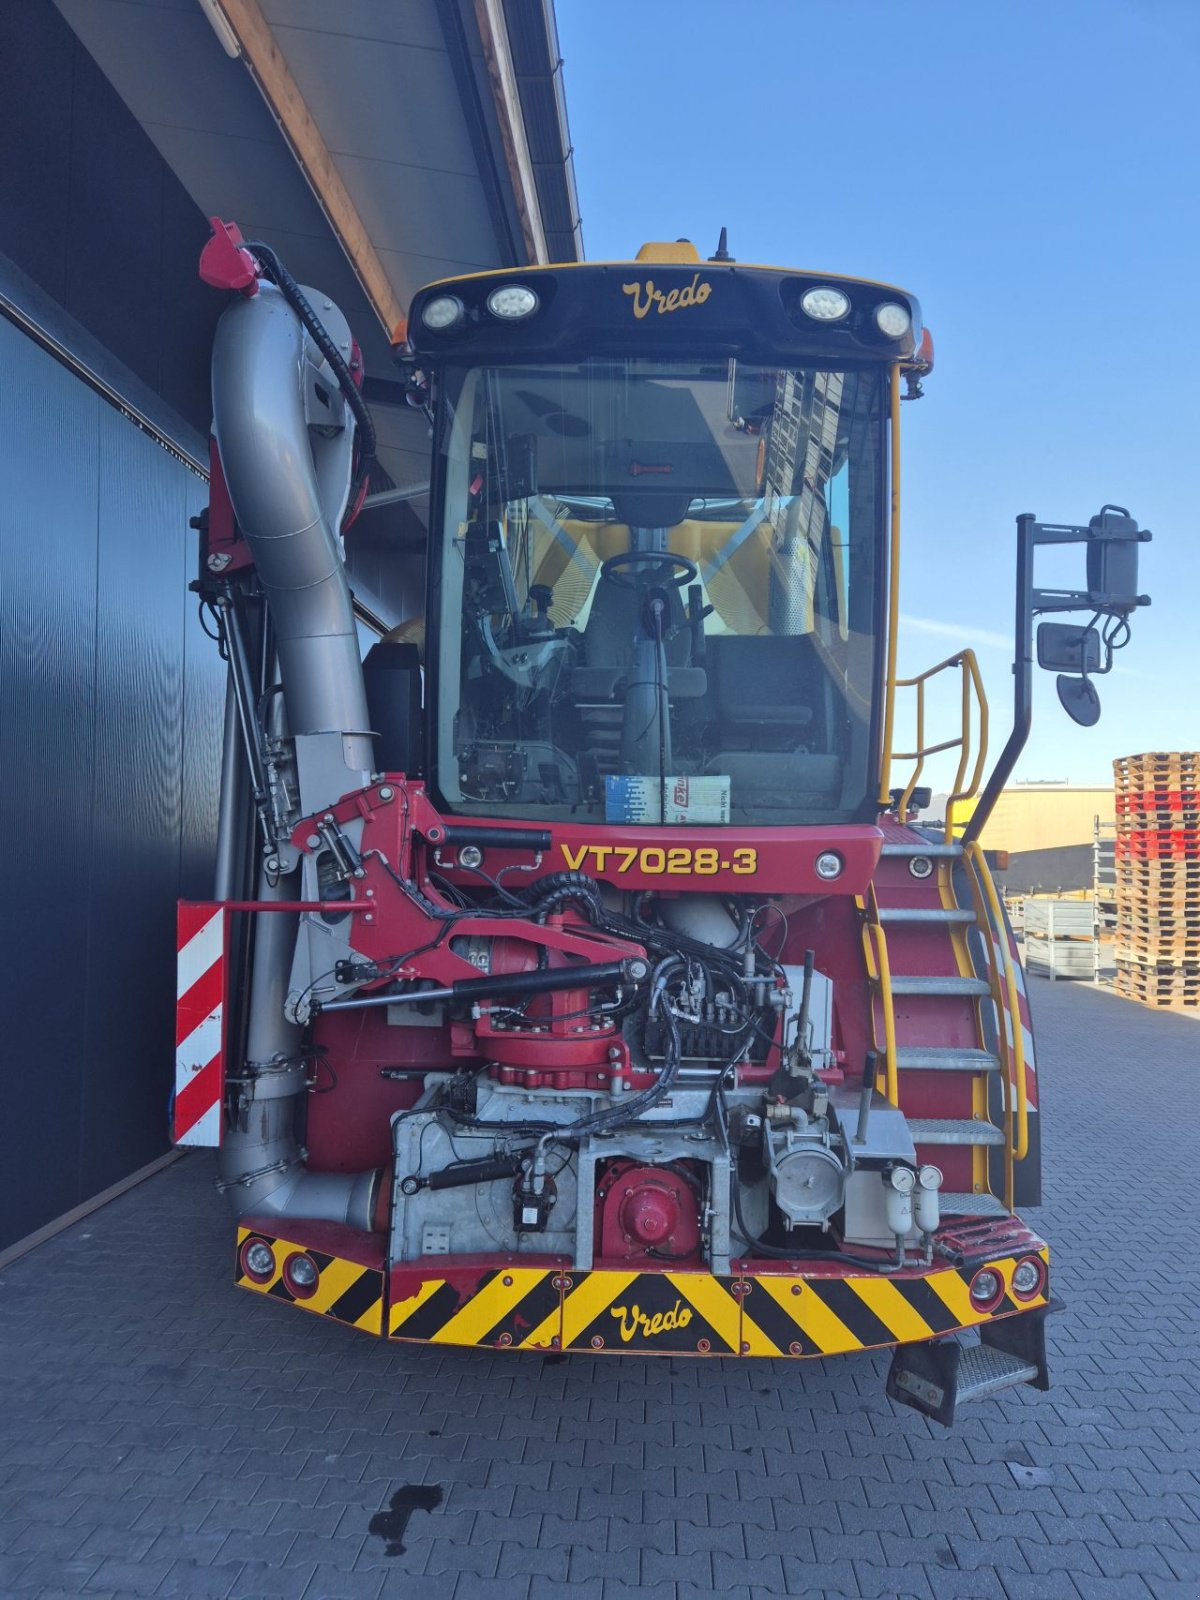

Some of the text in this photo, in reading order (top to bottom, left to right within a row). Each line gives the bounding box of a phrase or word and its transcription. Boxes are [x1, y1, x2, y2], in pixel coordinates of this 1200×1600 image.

[622, 273, 712, 319] Vredo
[560, 844, 757, 874] VT7028-3
[610, 1299, 693, 1343] Vredo
